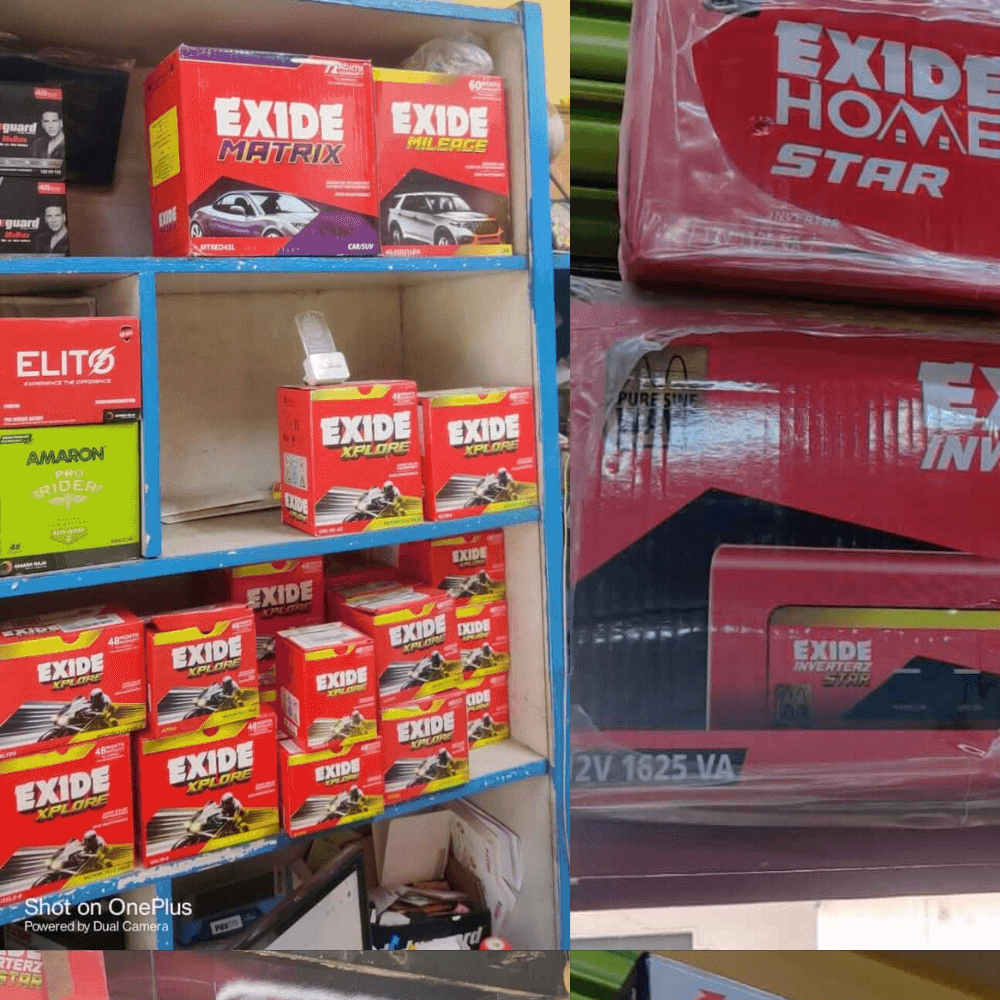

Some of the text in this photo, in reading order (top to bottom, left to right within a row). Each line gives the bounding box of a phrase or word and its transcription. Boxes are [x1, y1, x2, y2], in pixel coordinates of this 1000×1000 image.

[0, 122, 37, 134] guard
[214, 97, 345, 141] EXIDE
[391, 102, 488, 138] EXIDE
[217, 139, 344, 165] MATRIX
[407, 136, 489, 154] MILEAGE
[771, 143, 950, 199] STAR
[0, 218, 40, 230] guard
[618, 391, 659, 408] PURE
[320, 411, 411, 446] EXIDE
[447, 414, 519, 446] EXIDE
[26, 446, 105, 466] AMARON
[340, 440, 411, 460] XPLORE
[464, 438, 518, 458] XPLORE
[452, 547, 488, 565] EXIDE
[246, 580, 313, 608] EXIDE
[389, 614, 446, 646] EXIDE
[172, 636, 242, 670] EXIDE
[402, 634, 446, 653] XPLORE
[793, 639, 873, 662] EXIDE
[37, 653, 104, 684] EXIDE
[187, 658, 241, 678] XPLORE
[316, 667, 368, 692] EXIDE
[793, 661, 873, 673] INVERTERZ
[52, 672, 103, 691] XPLORE
[822, 672, 872, 688] STAR
[397, 711, 455, 743] EXIDE
[409, 731, 454, 750] XPLORE
[167, 742, 254, 784] EXIDE
[315, 759, 360, 783] EXIDE
[570, 753, 737, 782] 2V 1625 VA
[15, 766, 110, 813] EXIDE
[185, 770, 252, 795] XPLORE
[36, 793, 109, 822] XPLORE
